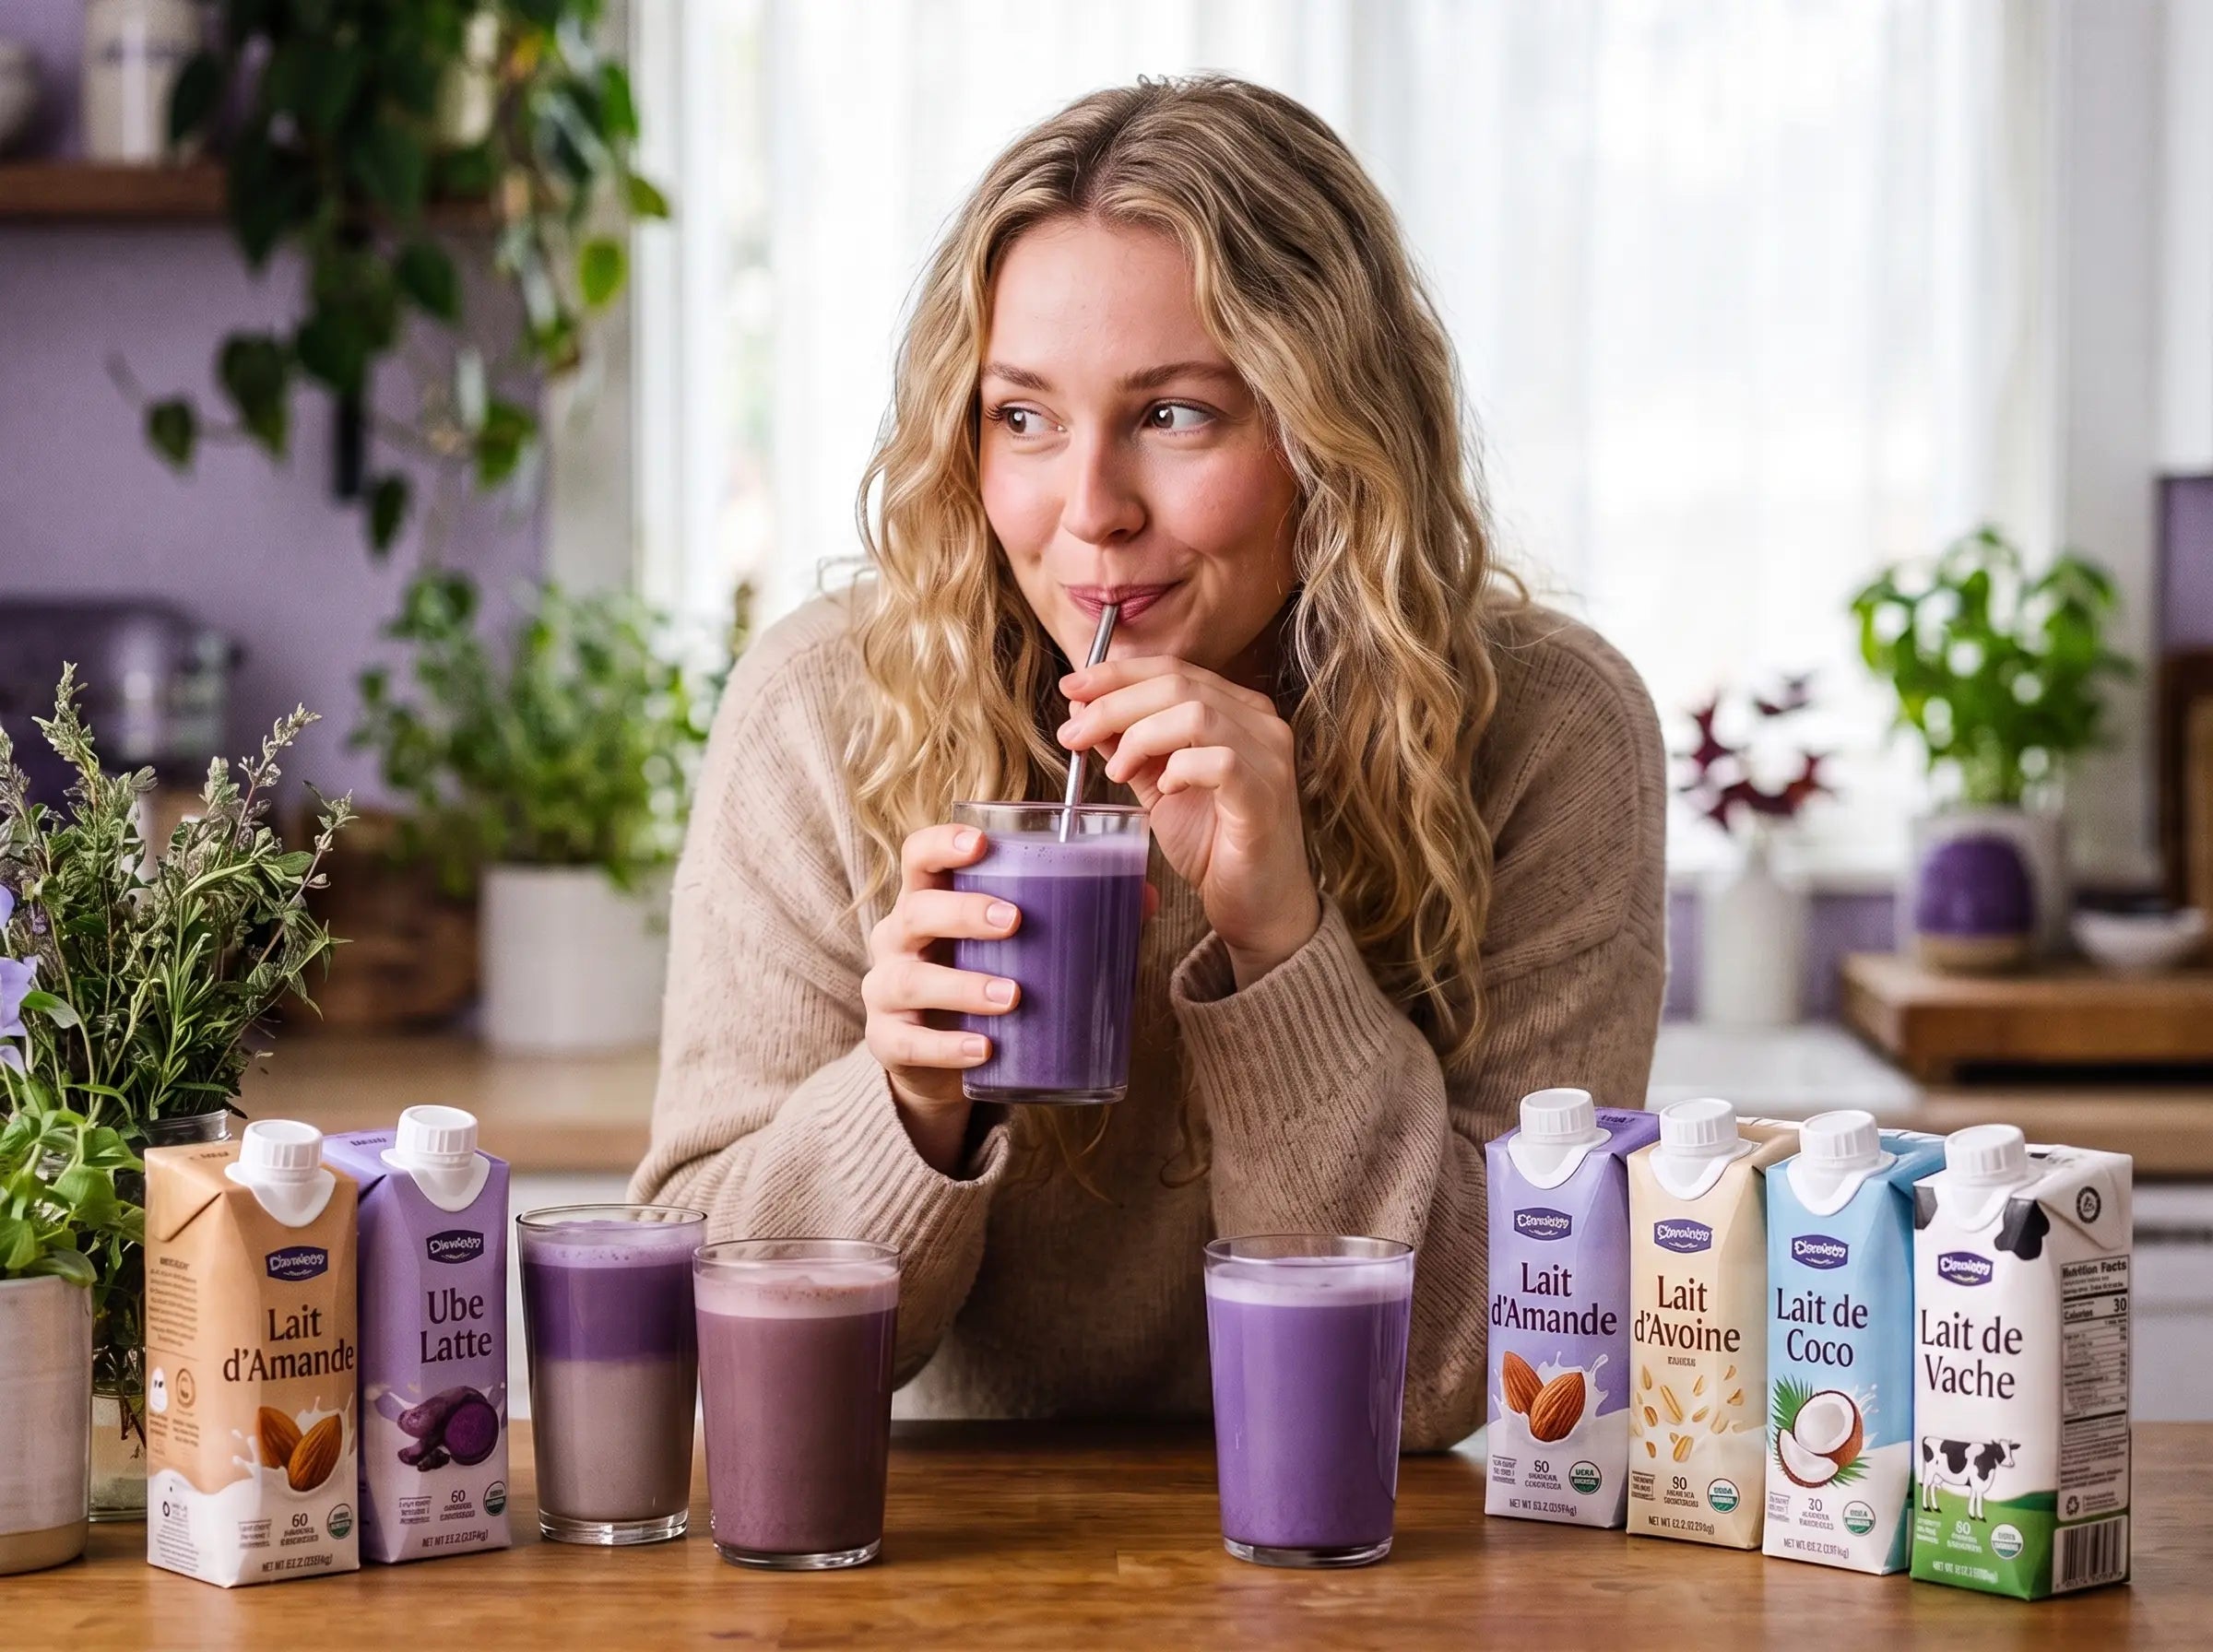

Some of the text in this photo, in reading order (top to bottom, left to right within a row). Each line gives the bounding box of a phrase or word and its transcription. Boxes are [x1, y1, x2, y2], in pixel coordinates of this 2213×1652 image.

[1521, 1262, 1572, 1297] Lait
[2101, 1260, 2126, 1272] Facts
[427, 1287, 484, 1324] Ube
[1657, 1275, 1708, 1313] Lait
[1777, 1288, 1868, 1329] Lait de
[2113, 1297, 2126, 1312] 30
[267, 1304, 323, 1341] Lait
[1492, 1294, 1616, 1336] d'Amande
[1635, 1310, 1740, 1352] d'Avoine
[1922, 1309, 2023, 1355] Lait de
[223, 1339, 354, 1382] d'Amande
[420, 1329, 491, 1364] Latte
[1787, 1328, 1853, 1367] Coco
[1924, 1353, 2015, 1399] Vache
[451, 1490, 466, 1503] 60
[1808, 1498, 1822, 1511] 30
[291, 1513, 308, 1528] 60
[1648, 1516, 1660, 1526] NET
[1783, 1538, 1796, 1549] NET
